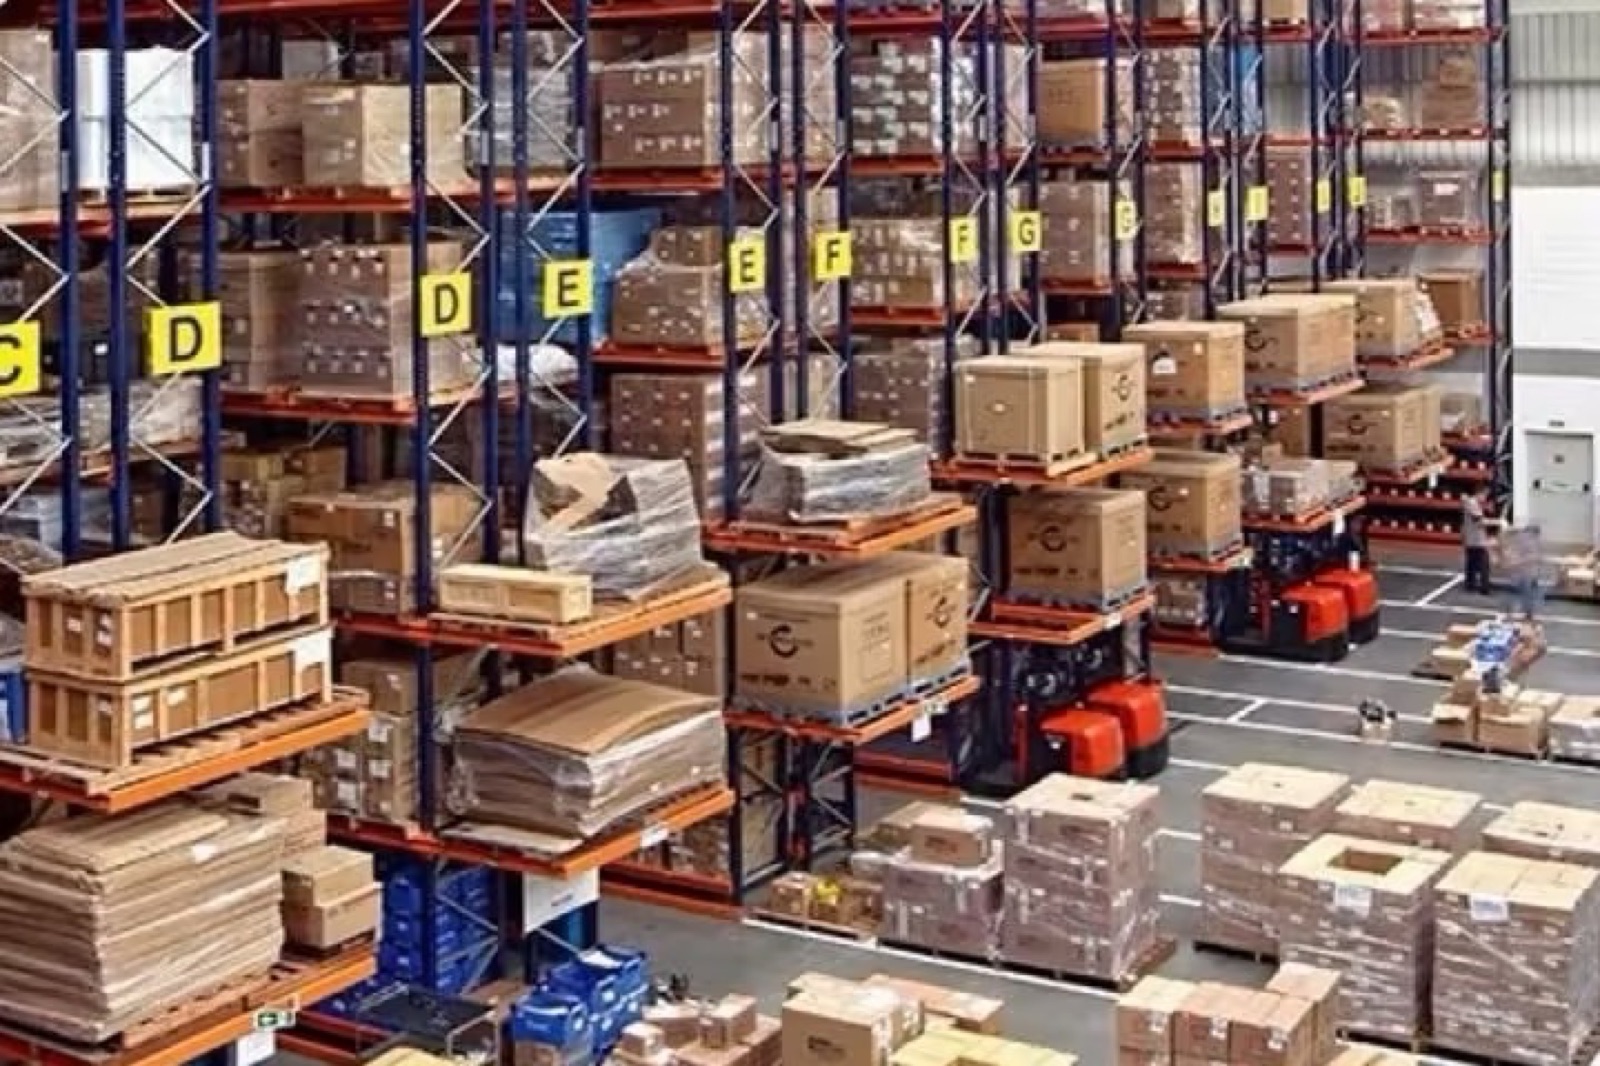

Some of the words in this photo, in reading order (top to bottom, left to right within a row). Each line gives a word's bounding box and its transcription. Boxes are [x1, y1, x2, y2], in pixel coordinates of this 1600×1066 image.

[957, 225, 968, 256] F
[1019, 216, 1034, 246] G
[740, 248, 755, 283] E
[826, 240, 842, 273] F
[434, 283, 457, 325] D
[556, 270, 578, 307] E
[168, 316, 202, 363] D
